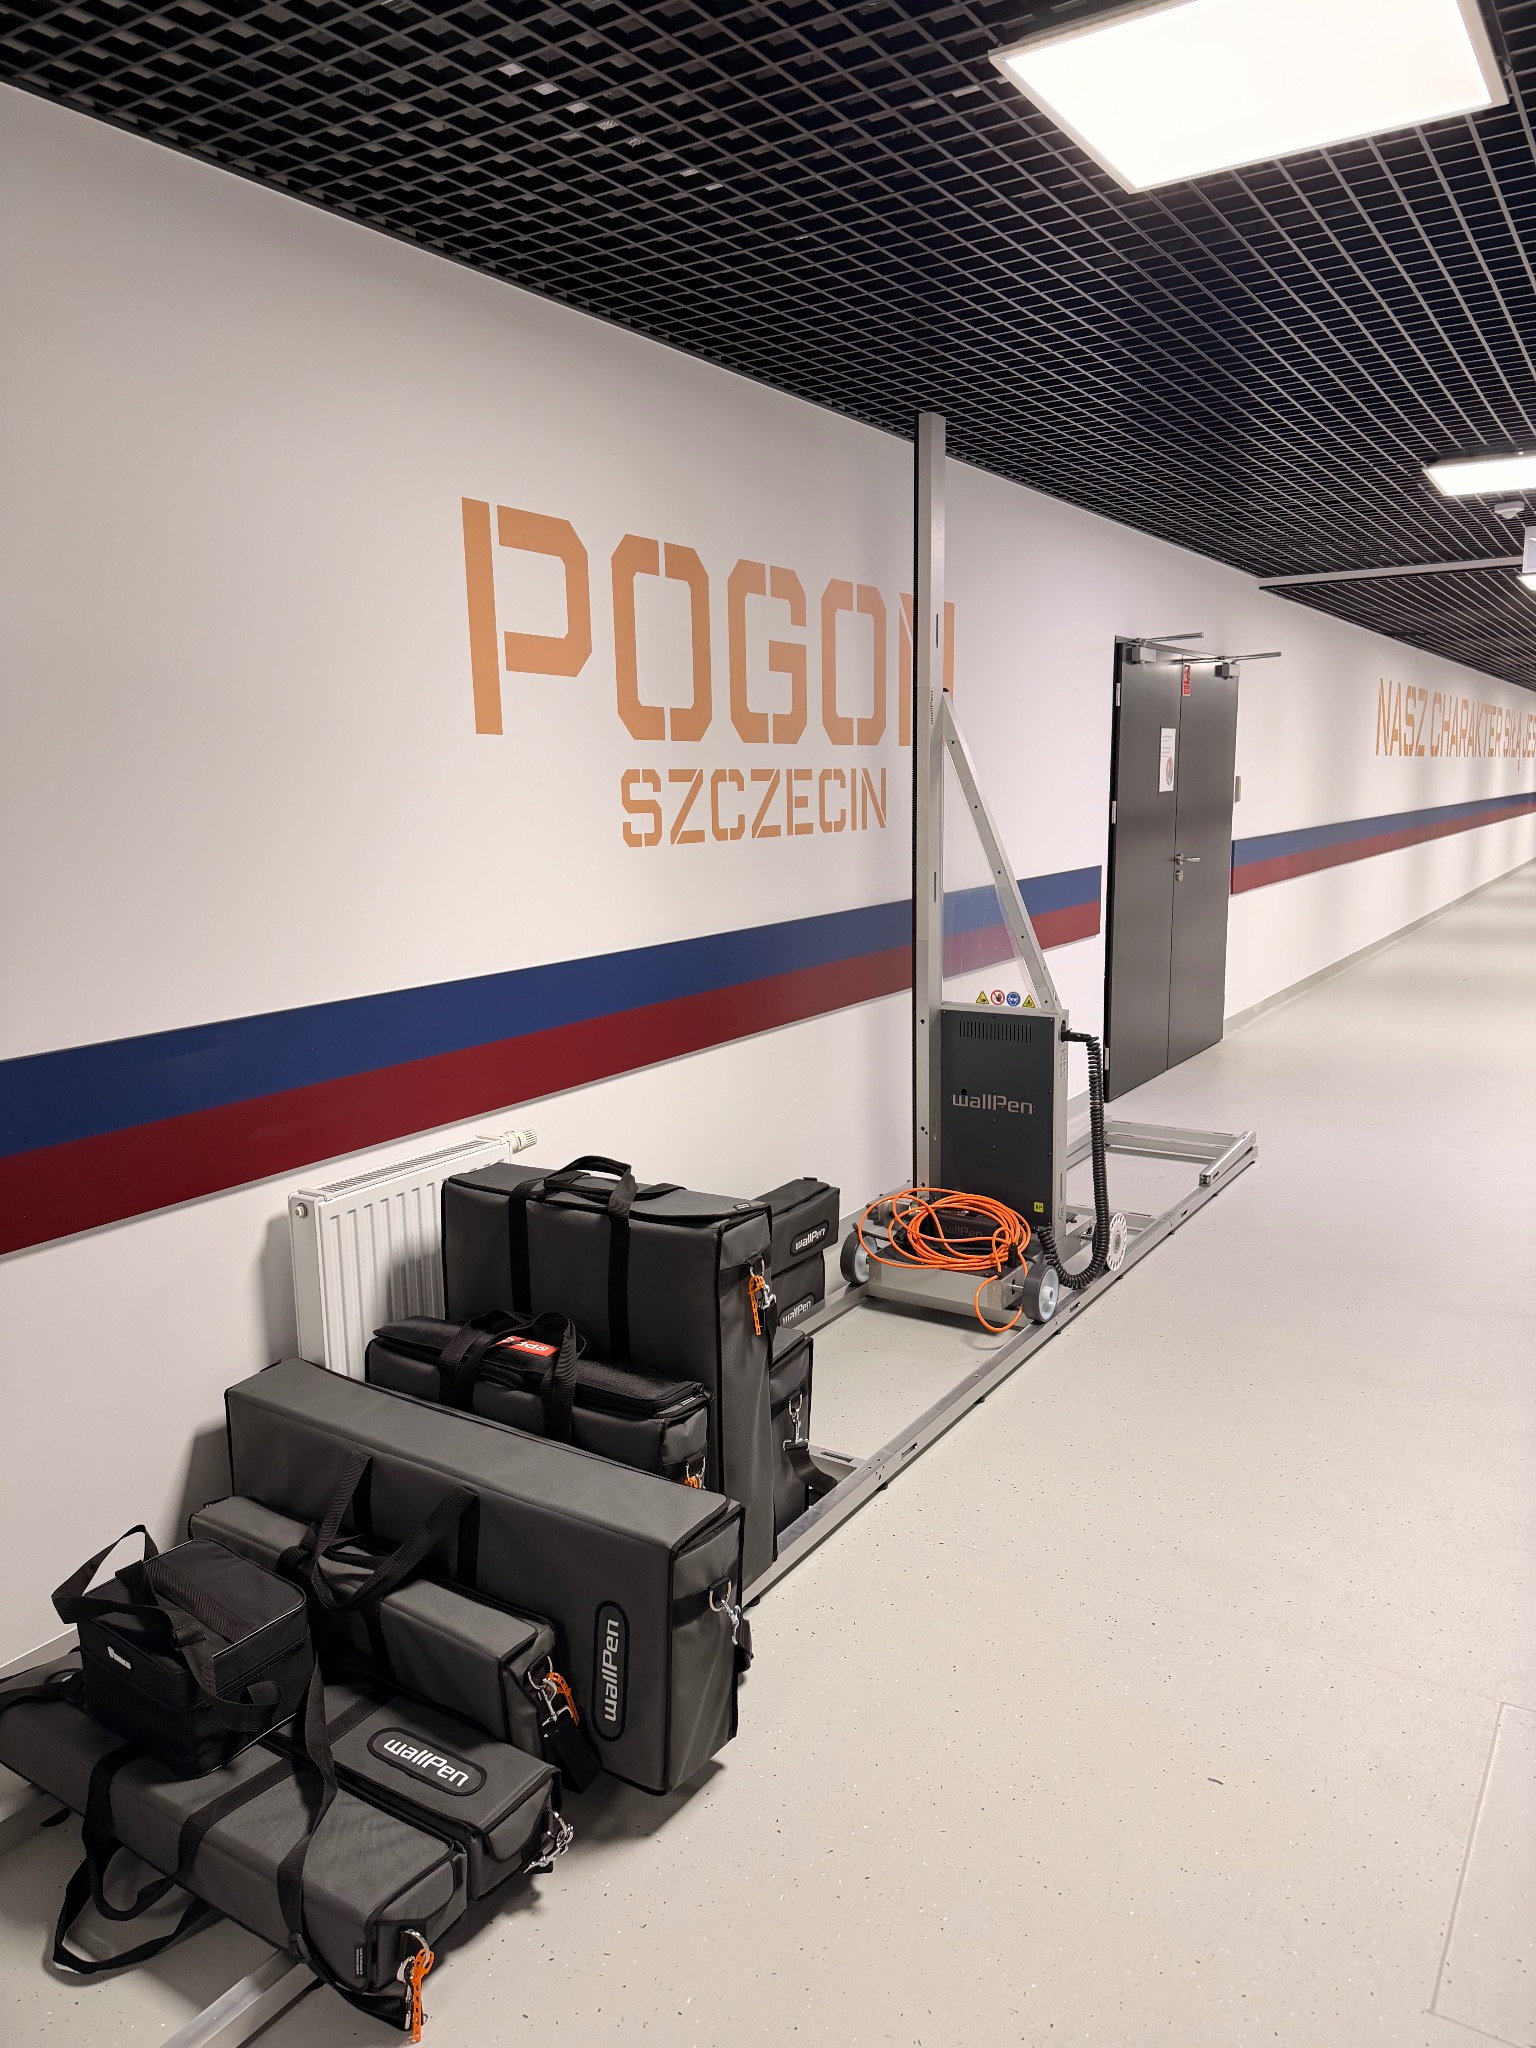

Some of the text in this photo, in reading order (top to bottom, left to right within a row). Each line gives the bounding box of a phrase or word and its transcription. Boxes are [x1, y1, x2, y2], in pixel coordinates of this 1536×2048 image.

[1375, 677, 1428, 757] NASZ
[1430, 691, 1504, 758] CHARAKTER
[620, 768, 887, 848] SZCZECIN
[952, 1093, 1033, 1115] wallPen
[795, 1227, 826, 1251] wallPen
[601, 1619, 620, 1722] wallPen
[383, 1738, 470, 1788] wallPen
